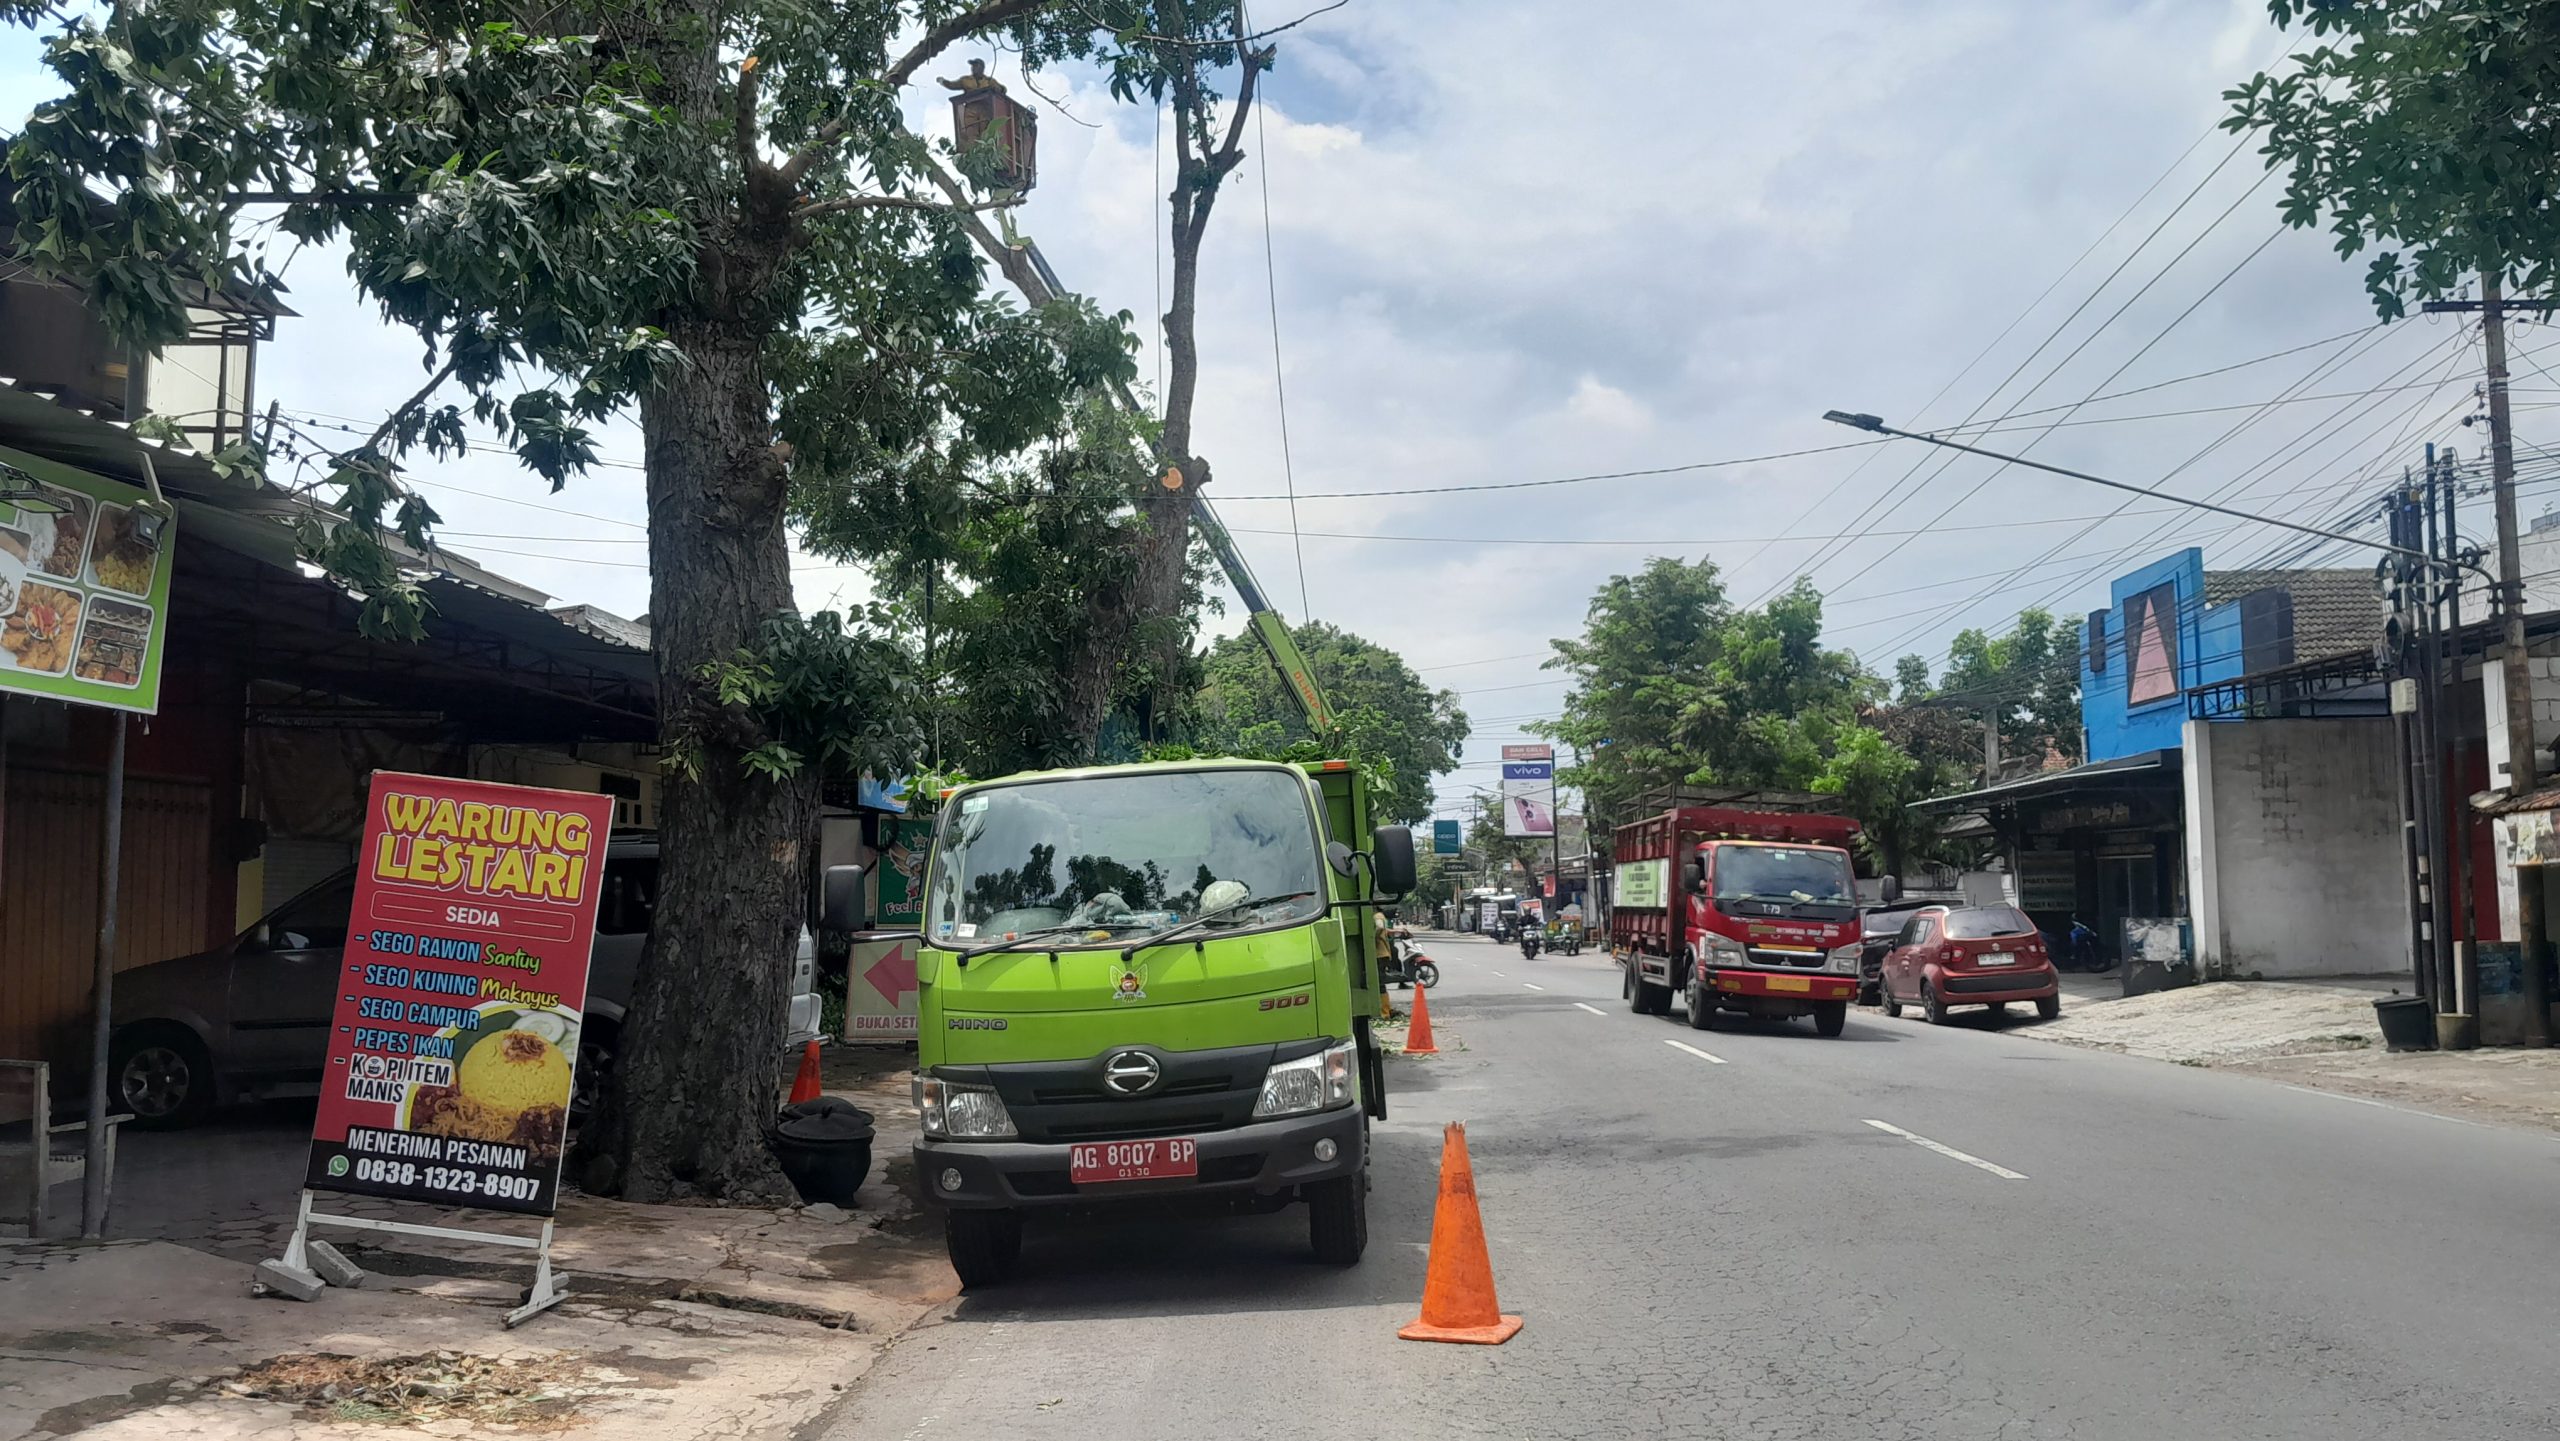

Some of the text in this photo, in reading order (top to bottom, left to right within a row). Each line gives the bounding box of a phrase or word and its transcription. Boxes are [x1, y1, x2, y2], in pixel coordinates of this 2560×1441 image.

[1513, 766, 1542, 775] vivo
[386, 793, 590, 852] WARUNG
[376, 834, 586, 900] LESTARI
[445, 905, 500, 928] SEDIA
[370, 930, 541, 975] SEGO RAWON Santuy
[364, 964, 560, 1010] SEGO KUNING Maknyus
[359, 997, 480, 1030] SEGO CAMPUR
[1258, 994, 1310, 1012] 300
[856, 1016, 890, 1029] BUKA
[948, 1018, 1008, 1032] HINO
[353, 1027, 455, 1060] PEPES IKAN
[407, 1060, 451, 1086] ITEM
[346, 1077, 405, 1103] MANIS
[347, 1128, 527, 1171] MENERIMA PESANAN
[1073, 1140, 1194, 1168] AG 8007 BP
[356, 1157, 541, 1201] 0838-1323-8907
